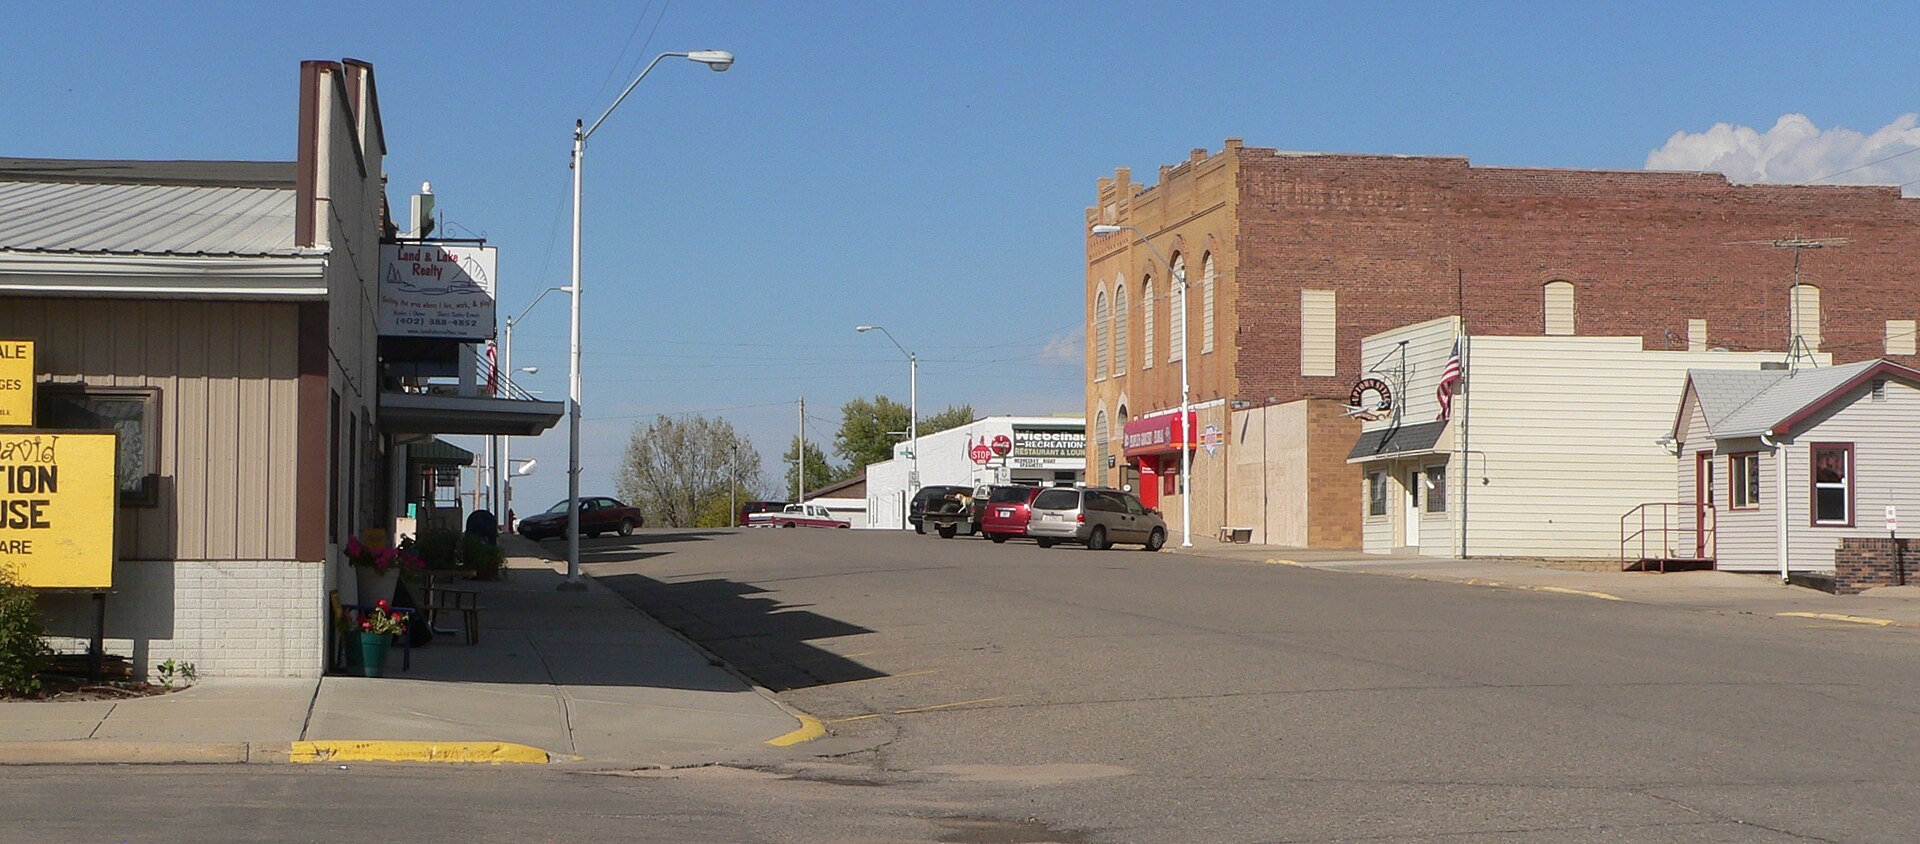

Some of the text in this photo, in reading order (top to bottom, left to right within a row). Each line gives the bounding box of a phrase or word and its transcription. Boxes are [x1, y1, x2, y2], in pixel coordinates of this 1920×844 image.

[398, 250, 459, 263] Land & Lake
[412, 262, 443, 280] Realty
[396, 317, 424, 326] (402)
[1351, 379, 1374, 402] UPTOWN
[0, 436, 59, 464] avid
[972, 450, 990, 459] STOP
[1015, 447, 1060, 456] RESTAURANT
